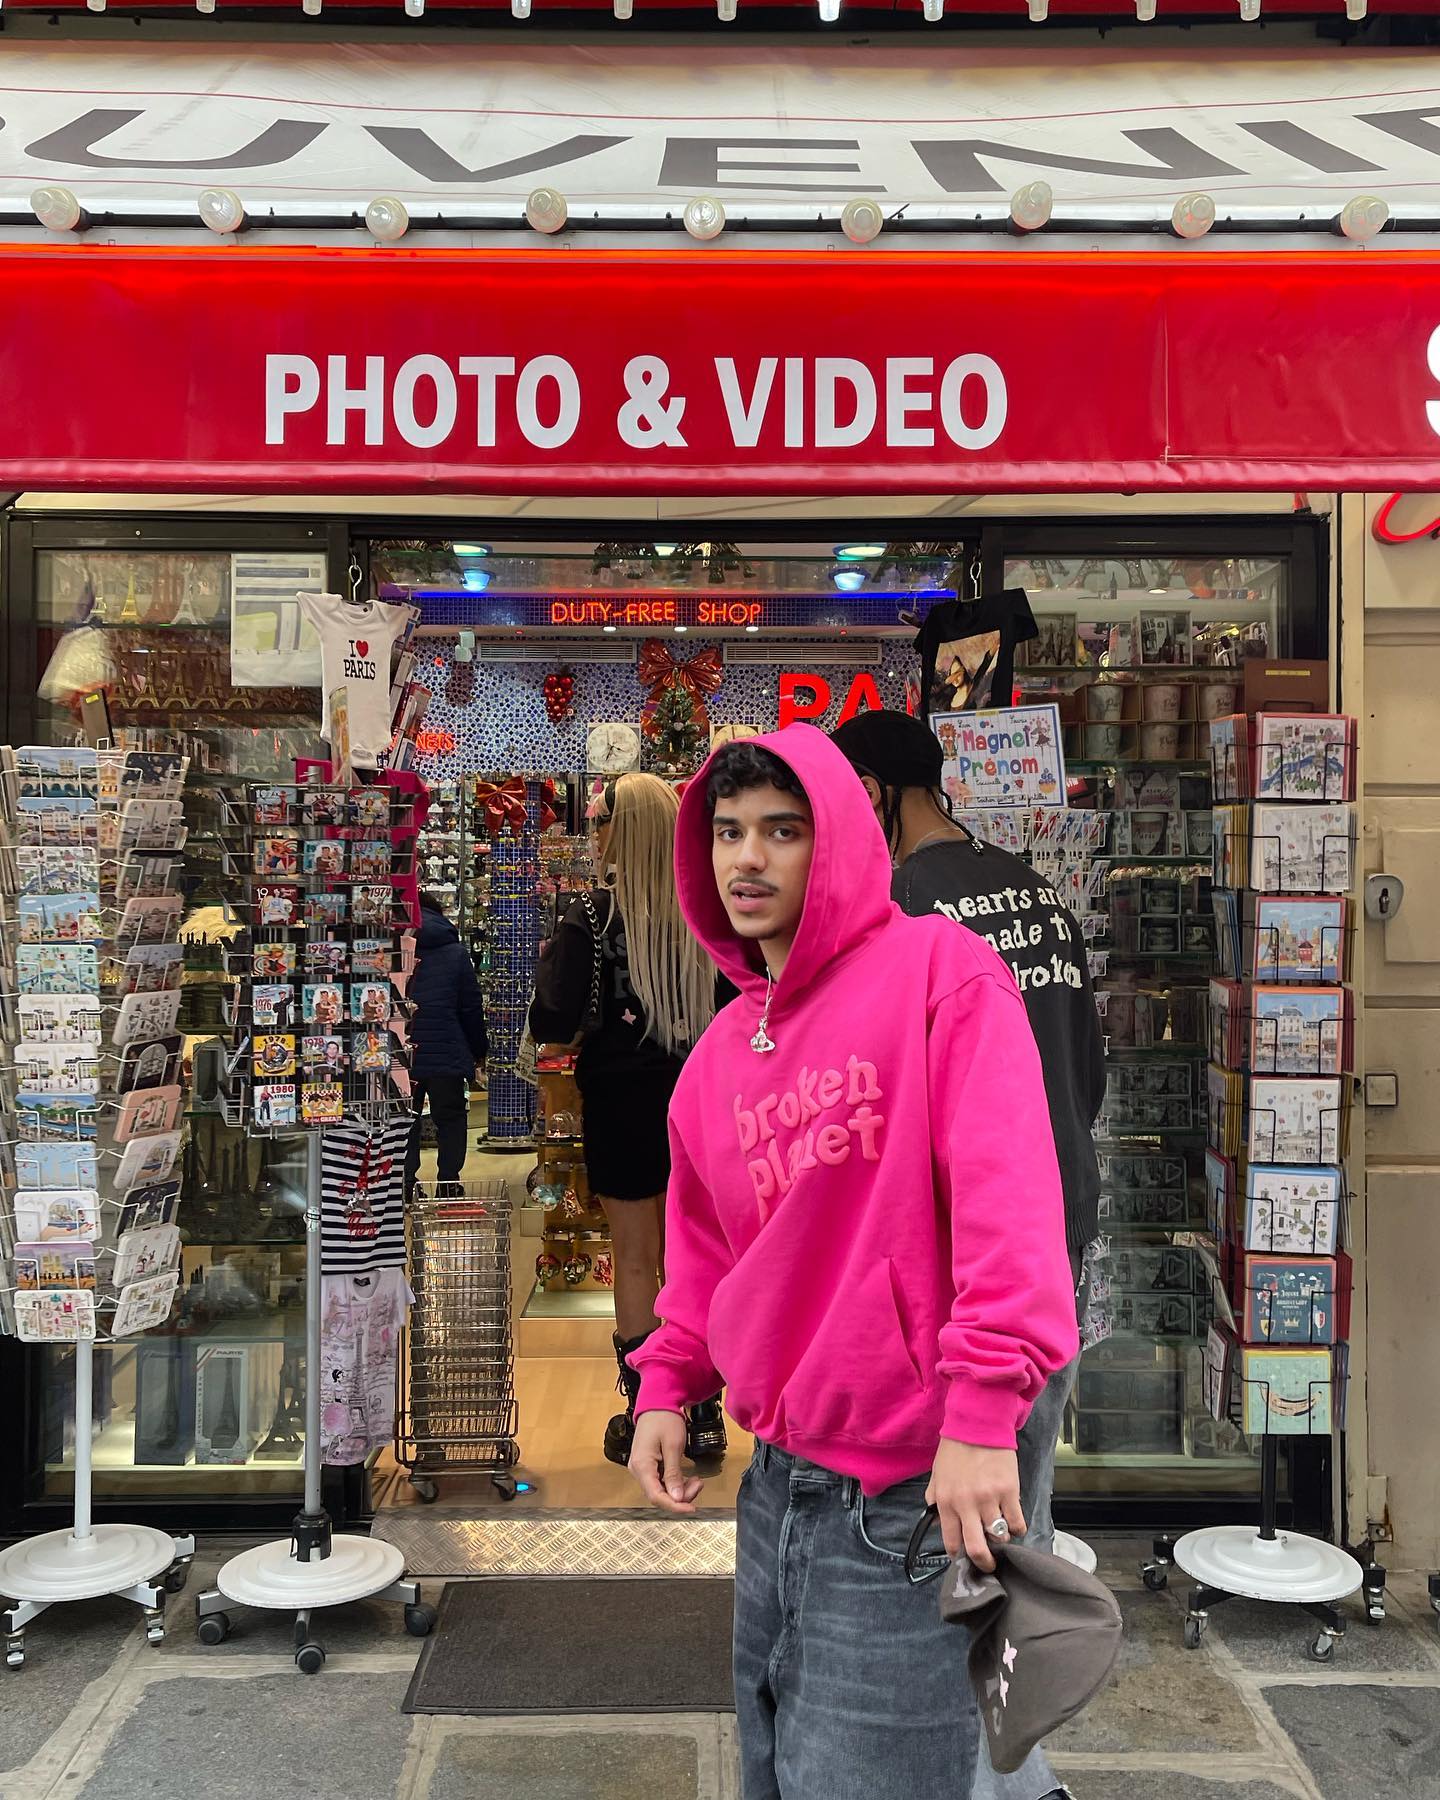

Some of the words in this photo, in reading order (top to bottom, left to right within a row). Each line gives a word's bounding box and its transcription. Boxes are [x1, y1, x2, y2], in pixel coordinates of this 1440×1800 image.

[0, 106, 1440, 193] UVENI
[265, 353, 581, 449] PHOTO
[617, 354, 688, 449] &
[714, 353, 1008, 450] VIDEO
[551, 601, 676, 624] DUTY-FREE
[698, 603, 762, 624] SHOP
[349, 639, 356, 658] I
[343, 659, 376, 681] PARIS
[962, 725, 1031, 754] Magnet
[960, 757, 1039, 778] Prénom
[933, 887, 1032, 923] hearts
[356, 942, 378, 951] 1966
[263, 1035, 287, 1045] 1978
[271, 1085, 294, 1094] 1980
[733, 1054, 884, 1153] broken
